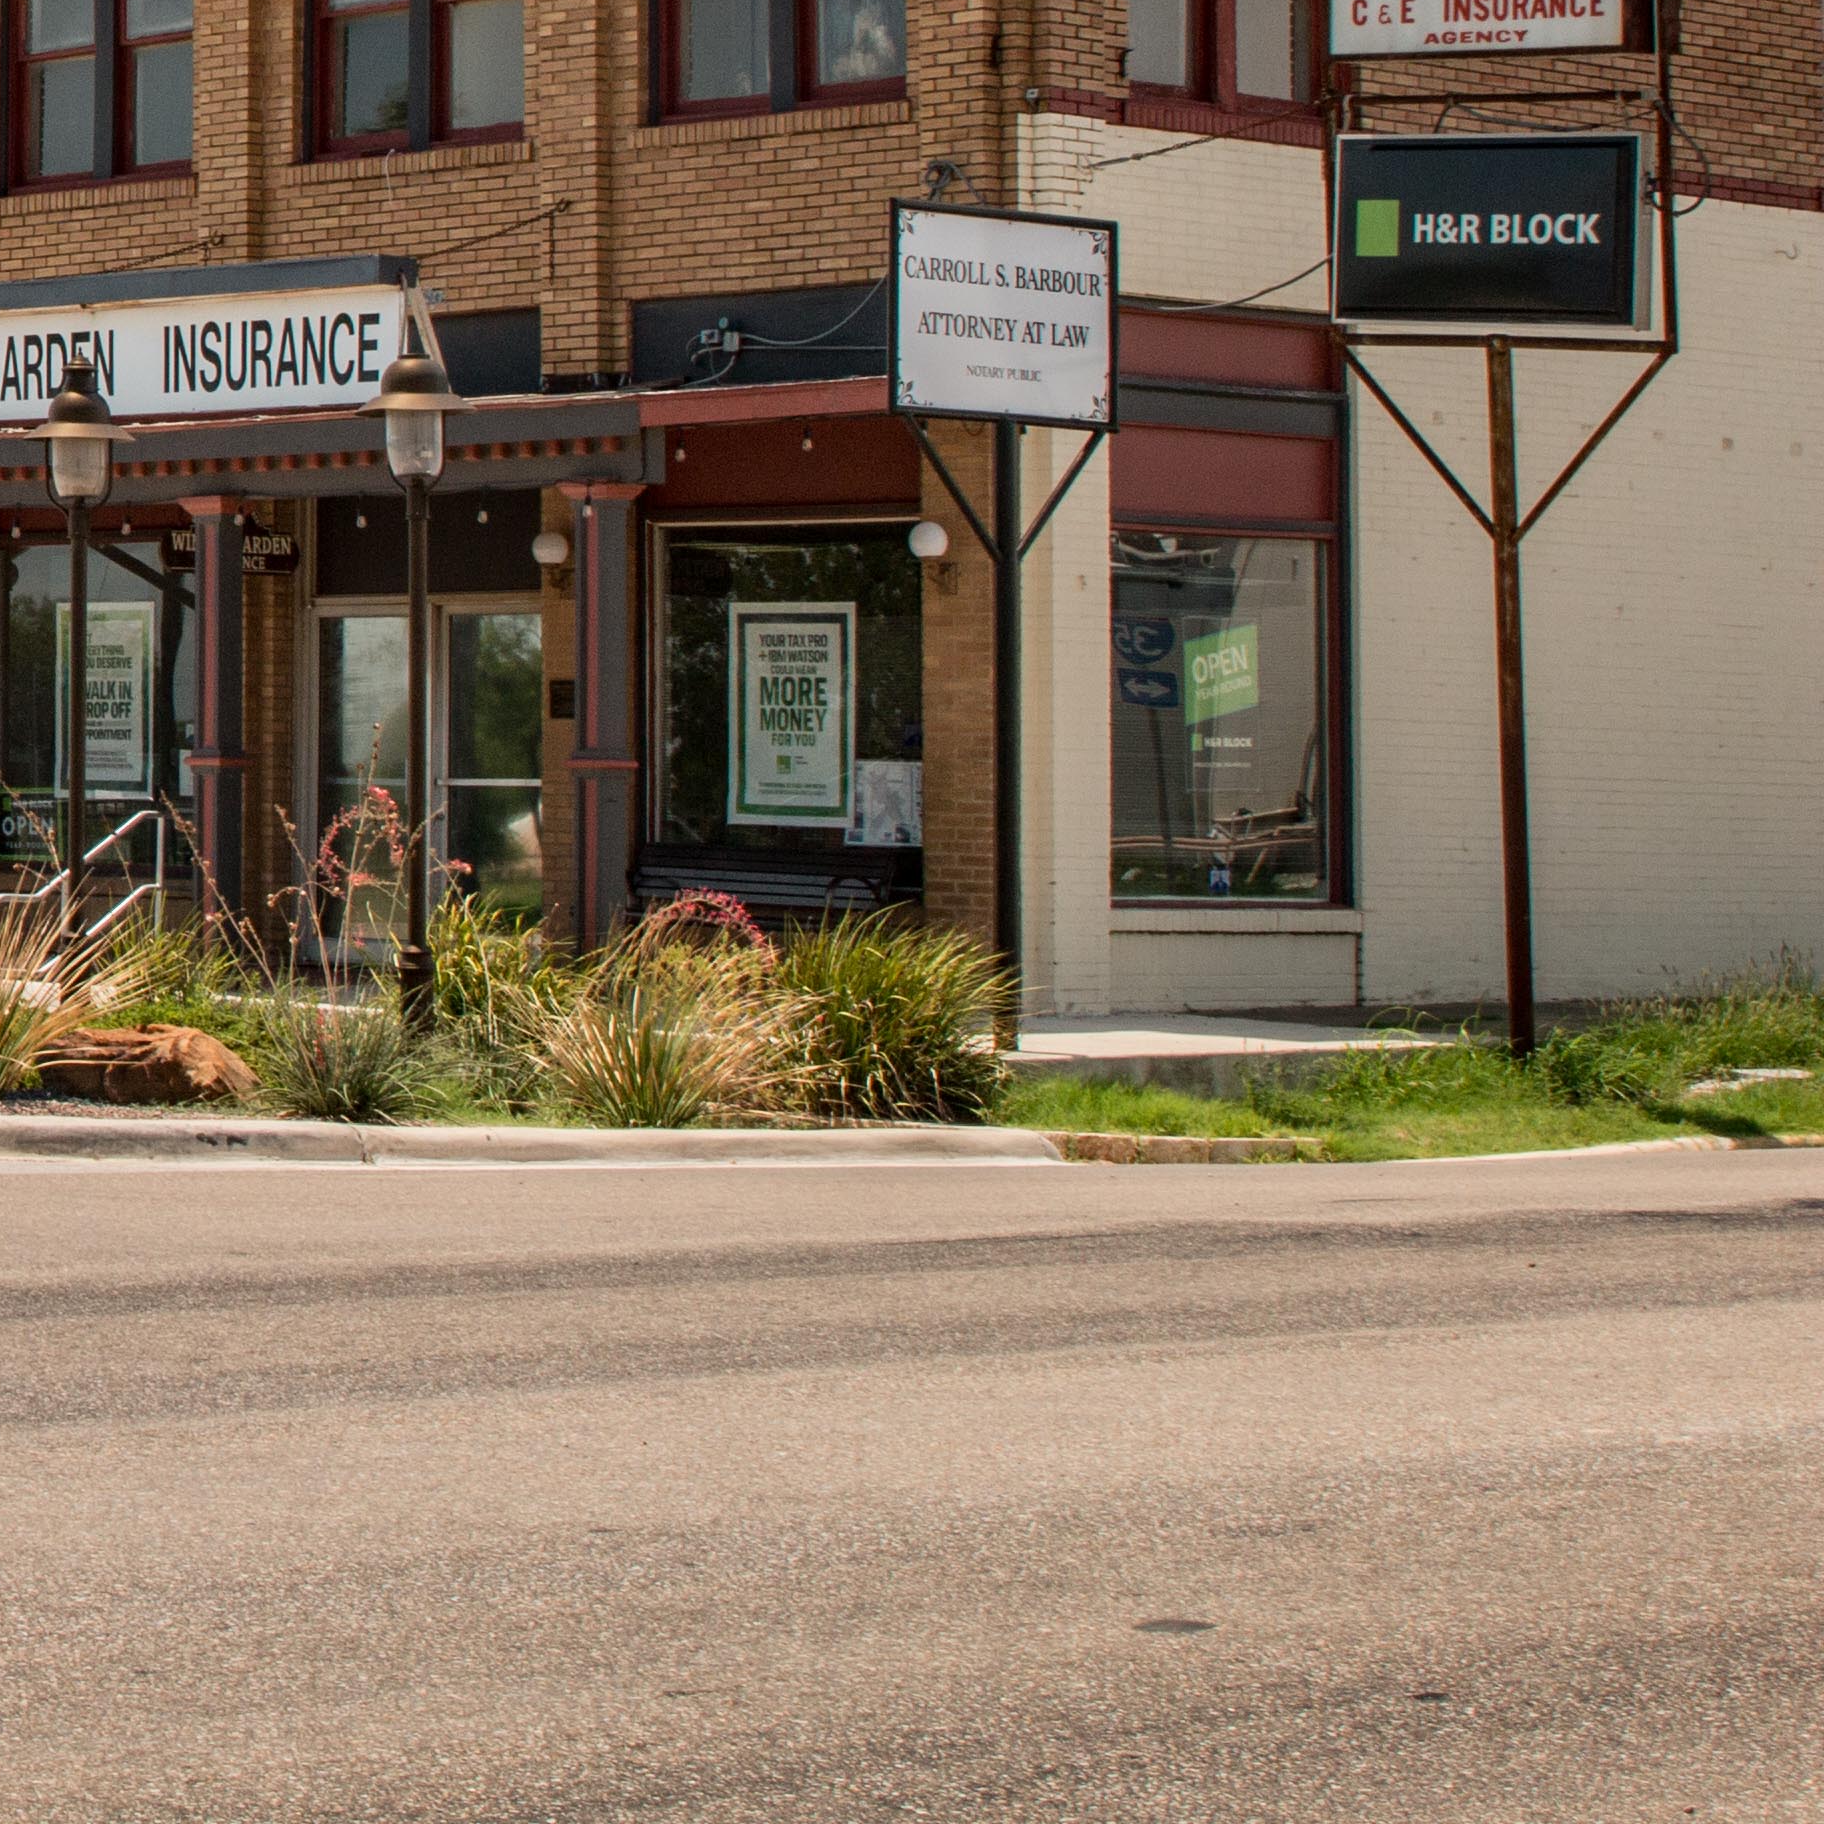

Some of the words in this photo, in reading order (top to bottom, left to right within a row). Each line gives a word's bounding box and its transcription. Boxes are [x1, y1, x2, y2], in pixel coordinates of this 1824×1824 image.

[1378, 4, 1392, 25] &
[1423, 29, 1529, 45] AGENCY
[1413, 213, 1480, 244] H&R
[1489, 213, 1601, 244] BLOCK
[904, 255, 990, 286] CARROLL
[995, 263, 1010, 288] S.
[1015, 265, 1102, 297] BARBOUR
[917, 311, 1018, 342] ATTORNEY
[1021, 320, 1045, 345] AT
[1051, 323, 1090, 348] LAW
[163, 312, 381, 393] INSURANCE
[966, 364, 1005, 379] NOTARY
[1007, 368, 1042, 382] PUBLIC
[242, 536, 292, 555] ARDEN
[759, 634, 785, 647] YOUR
[808, 634, 828, 647] PRO
[96, 656, 132, 669] DESERVE
[788, 650, 828, 662] WATSON
[1192, 645, 1248, 683] OPEN
[760, 676, 827, 706] MORE
[86, 702, 109, 718] ROP
[111, 702, 131, 718] OFF
[760, 708, 827, 731] MONEY
[85, 728, 131, 740] PPOINTMENT
[771, 734, 791, 746] FOR
[794, 734, 816, 746] YOU
[1224, 737, 1252, 747] BLOCK
[2, 816, 54, 836] OPEN
